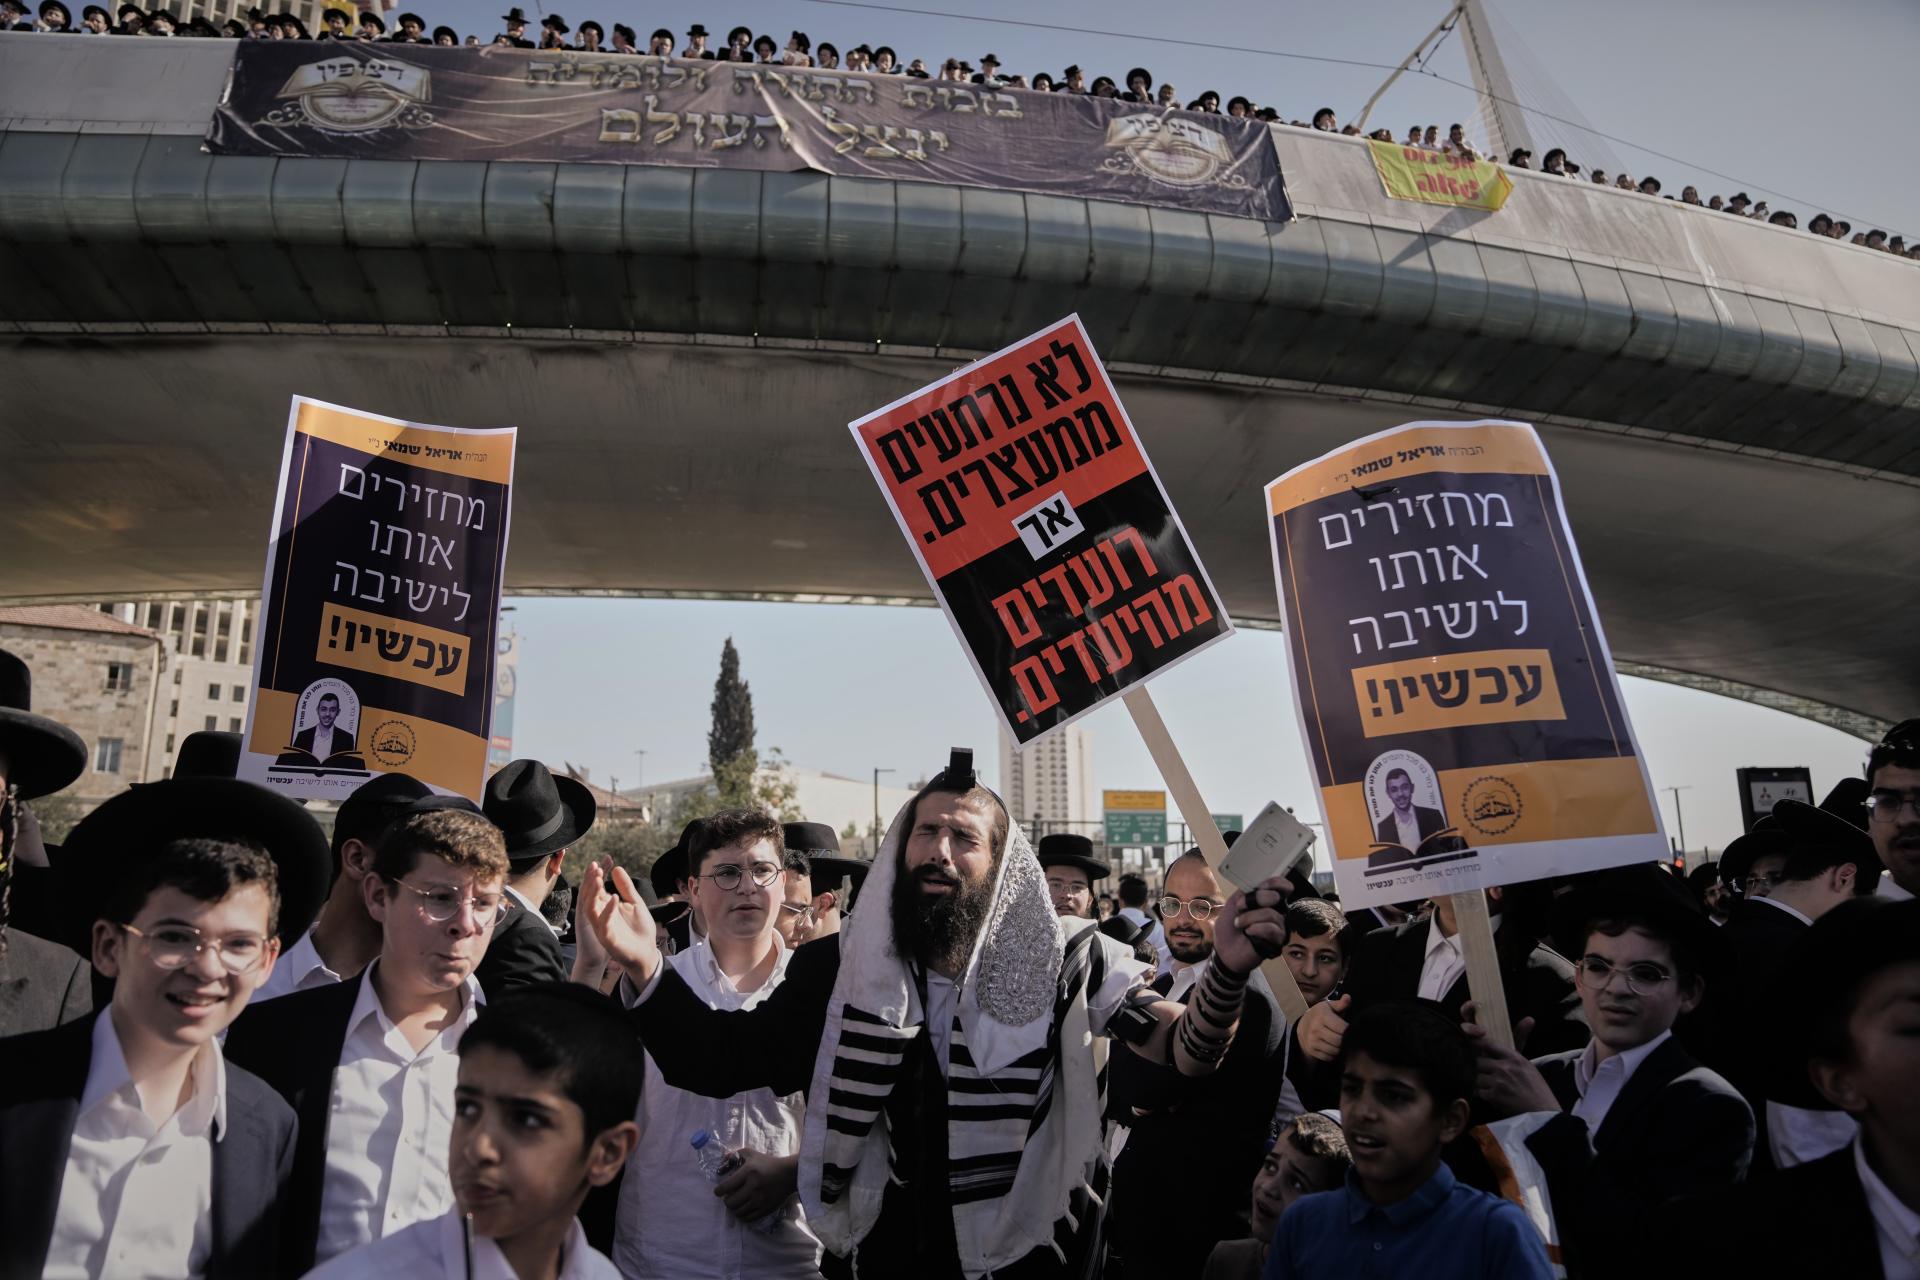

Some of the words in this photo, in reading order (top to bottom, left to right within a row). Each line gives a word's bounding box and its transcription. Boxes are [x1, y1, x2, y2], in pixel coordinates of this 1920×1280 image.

[527, 56, 706, 91] ולומדיה
[733, 68, 875, 104] התורה
[599, 94, 792, 150] העולם
[903, 83, 1024, 119] בזכות
[1027, 339, 1092, 410] לא
[383, 440, 422, 456] שמאי
[425, 446, 463, 461] אריאל
[877, 373, 1033, 485] נרתעים
[1397, 445, 1446, 463] אריאל
[917, 400, 1123, 545] ממעצרים.
[1350, 455, 1394, 477] שמאי
[338, 463, 486, 530] מחזירים
[1016, 498, 1074, 549] אך
[1317, 489, 1513, 550] מחזירים
[368, 519, 455, 570] אותו
[1368, 544, 1488, 592] אותו
[332, 561, 472, 621] לישיבה
[991, 526, 1158, 650] רועדים
[326, 614, 463, 678] עכשיו!
[1009, 574, 1213, 724] מהיעדים.
[1349, 590, 1529, 655] לישיבה
[1366, 664, 1542, 717] עכשיו!
